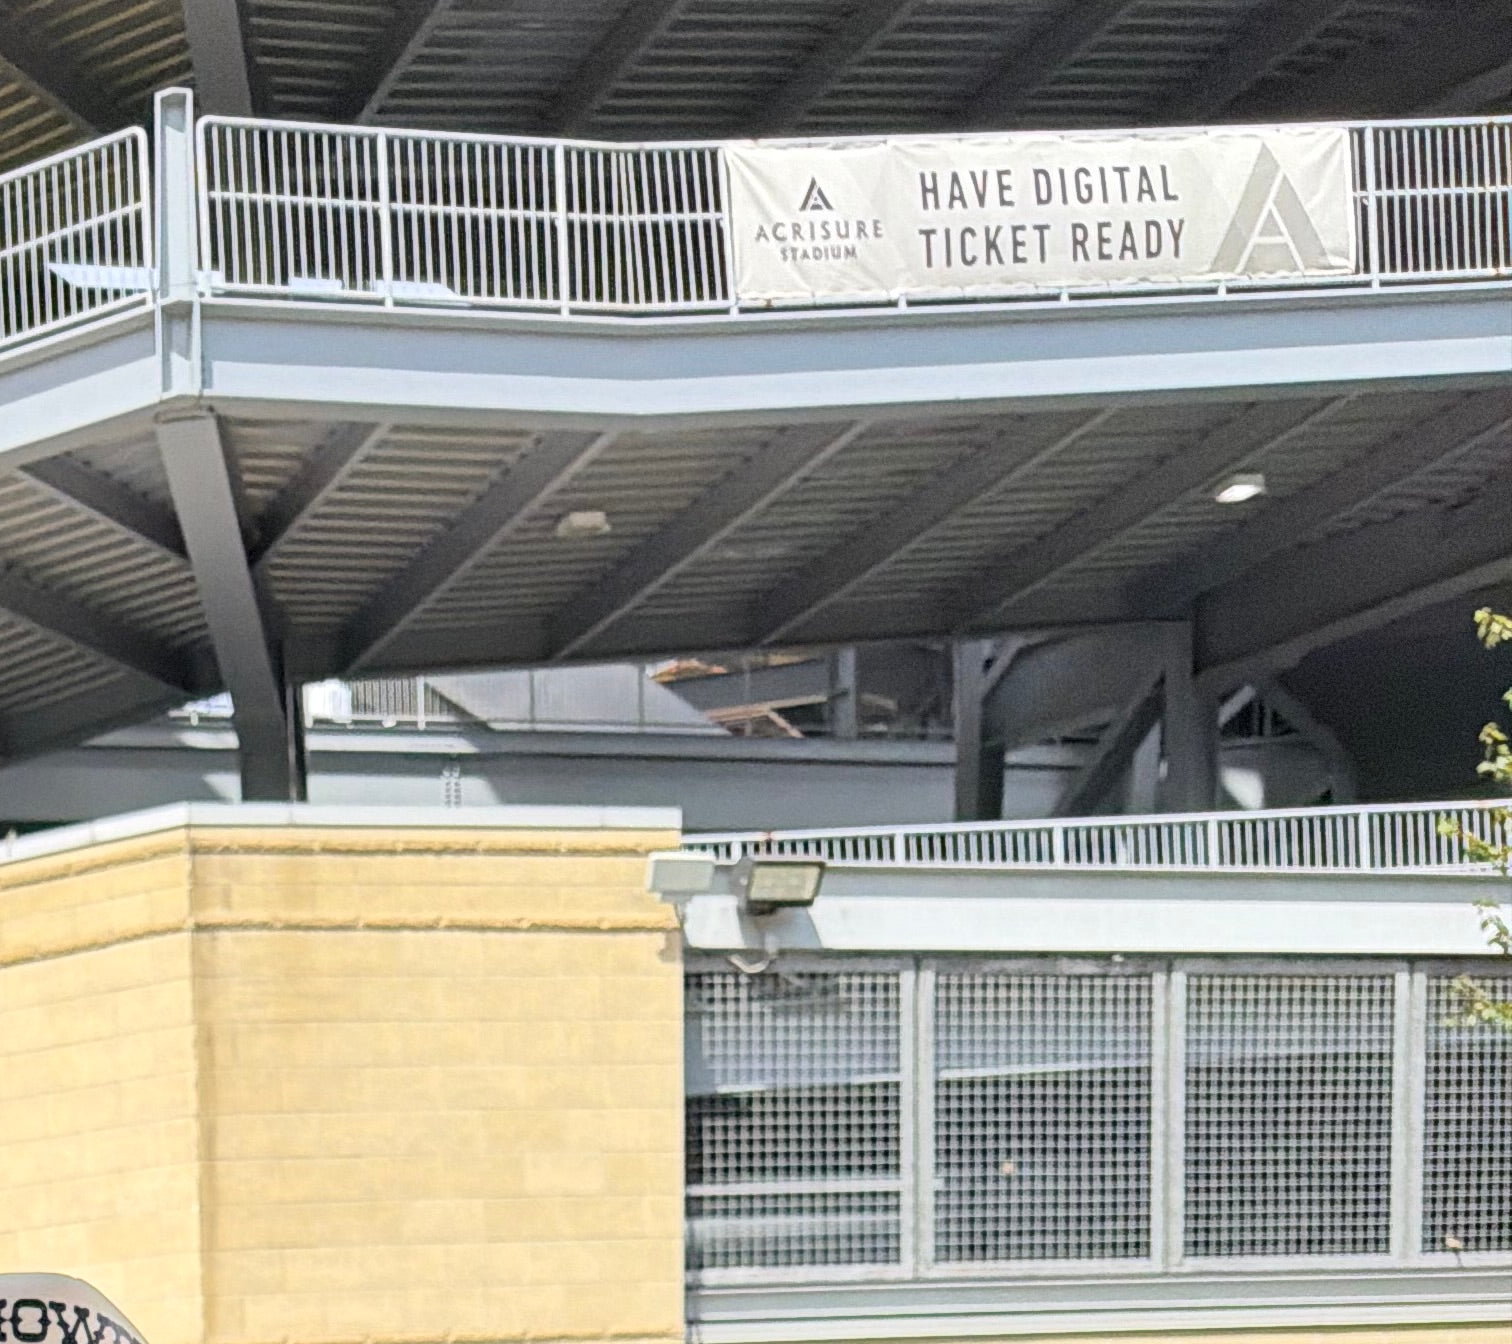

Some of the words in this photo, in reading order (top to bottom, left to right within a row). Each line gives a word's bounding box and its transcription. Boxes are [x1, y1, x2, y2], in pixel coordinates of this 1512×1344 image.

[920, 168, 1014, 212] HAVE
[1033, 163, 1179, 207] DIGITAL
[754, 218, 884, 242] ACRISURE
[918, 224, 1051, 269] TICKET
[1071, 218, 1186, 264] READY
[780, 243, 858, 262] STADIUM
